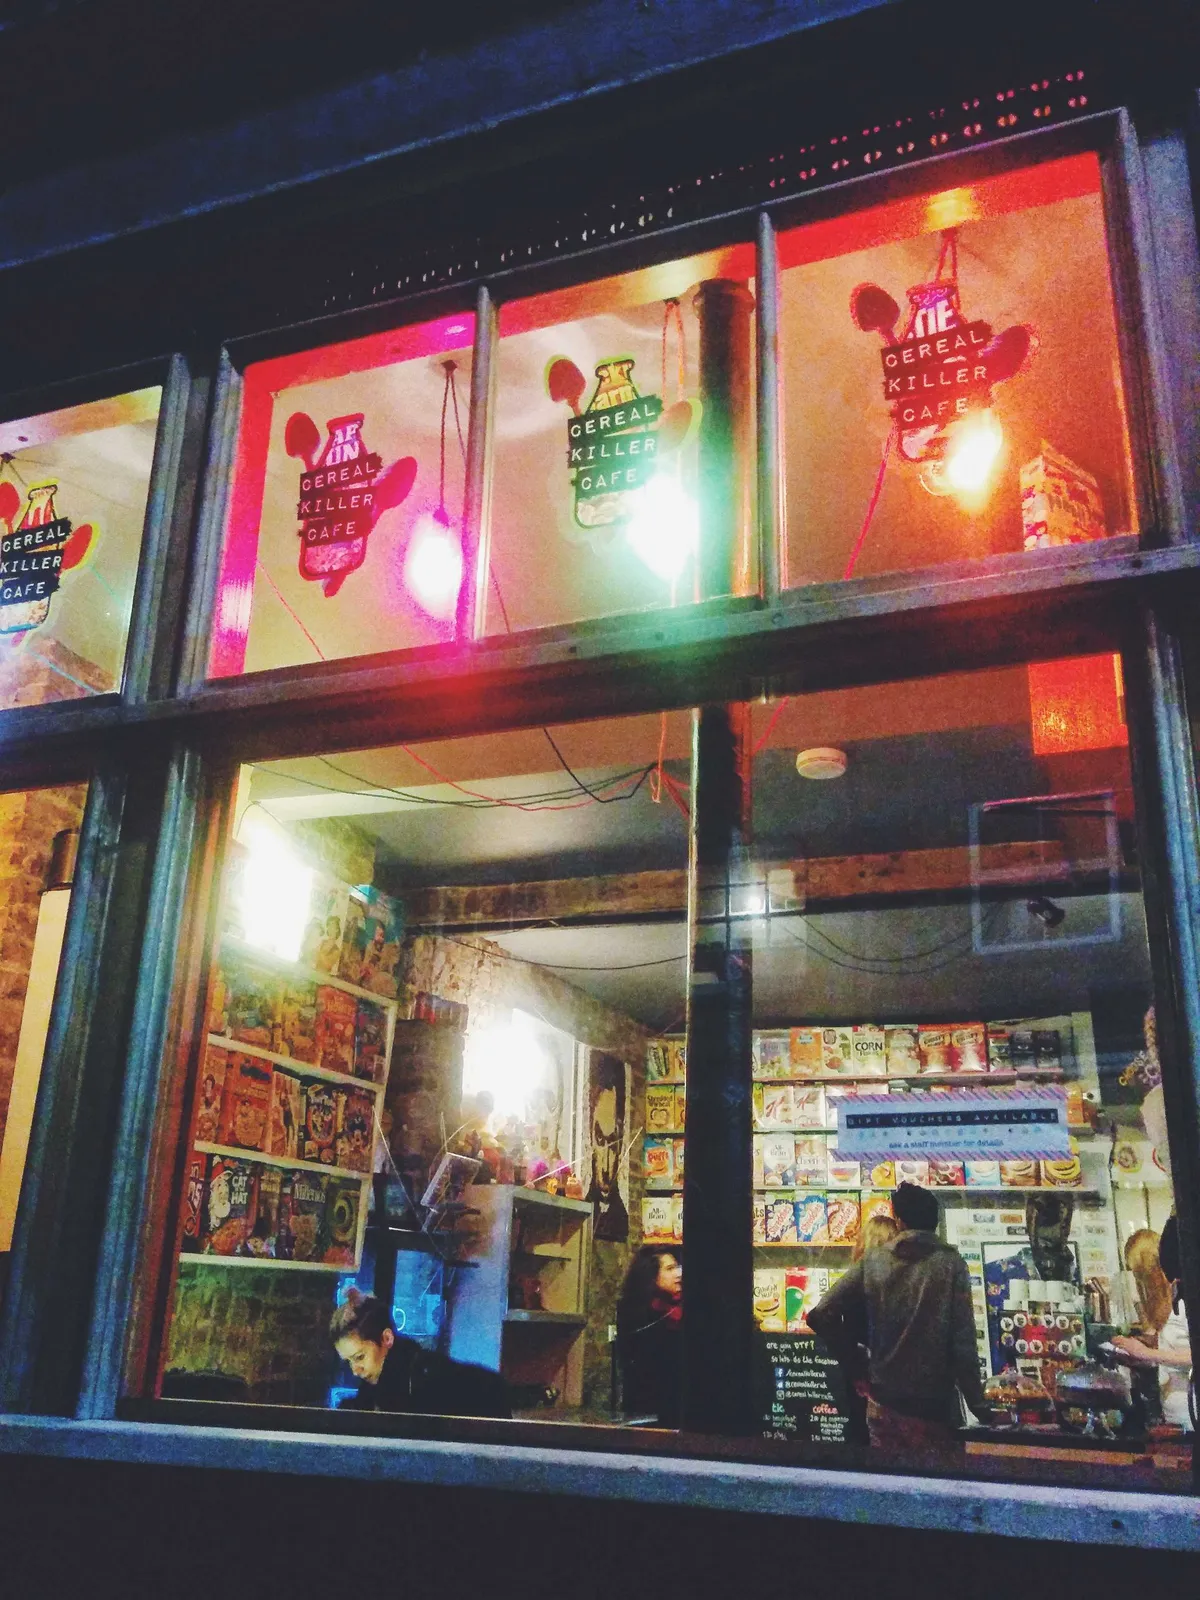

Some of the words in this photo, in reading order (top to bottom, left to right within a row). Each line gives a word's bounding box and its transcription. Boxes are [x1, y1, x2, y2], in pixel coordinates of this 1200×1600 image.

[885, 330, 984, 367] CEREAL
[888, 365, 987, 393] KILLER
[903, 397, 969, 422] CAFE
[570, 403, 656, 438] CEREAL
[571, 438, 656, 461] KILLER
[302, 461, 375, 491] CEREAL
[581, 468, 637, 490] CAFE
[301, 493, 373, 514] KILLER
[2, 525, 66, 553] CEREAL
[307, 521, 356, 540] CAFE
[1, 555, 62, 573] KILLER
[3, 581, 46, 599] CAFE
[855, 1042, 883, 1051] CORN
[974, 1112, 1057, 1121] AVAILABLE
[231, 1191, 248, 1204] HAT
[780, 1343, 791, 1352] you
[802, 1355, 813, 1364] the
[812, 1403, 839, 1414] coffee
